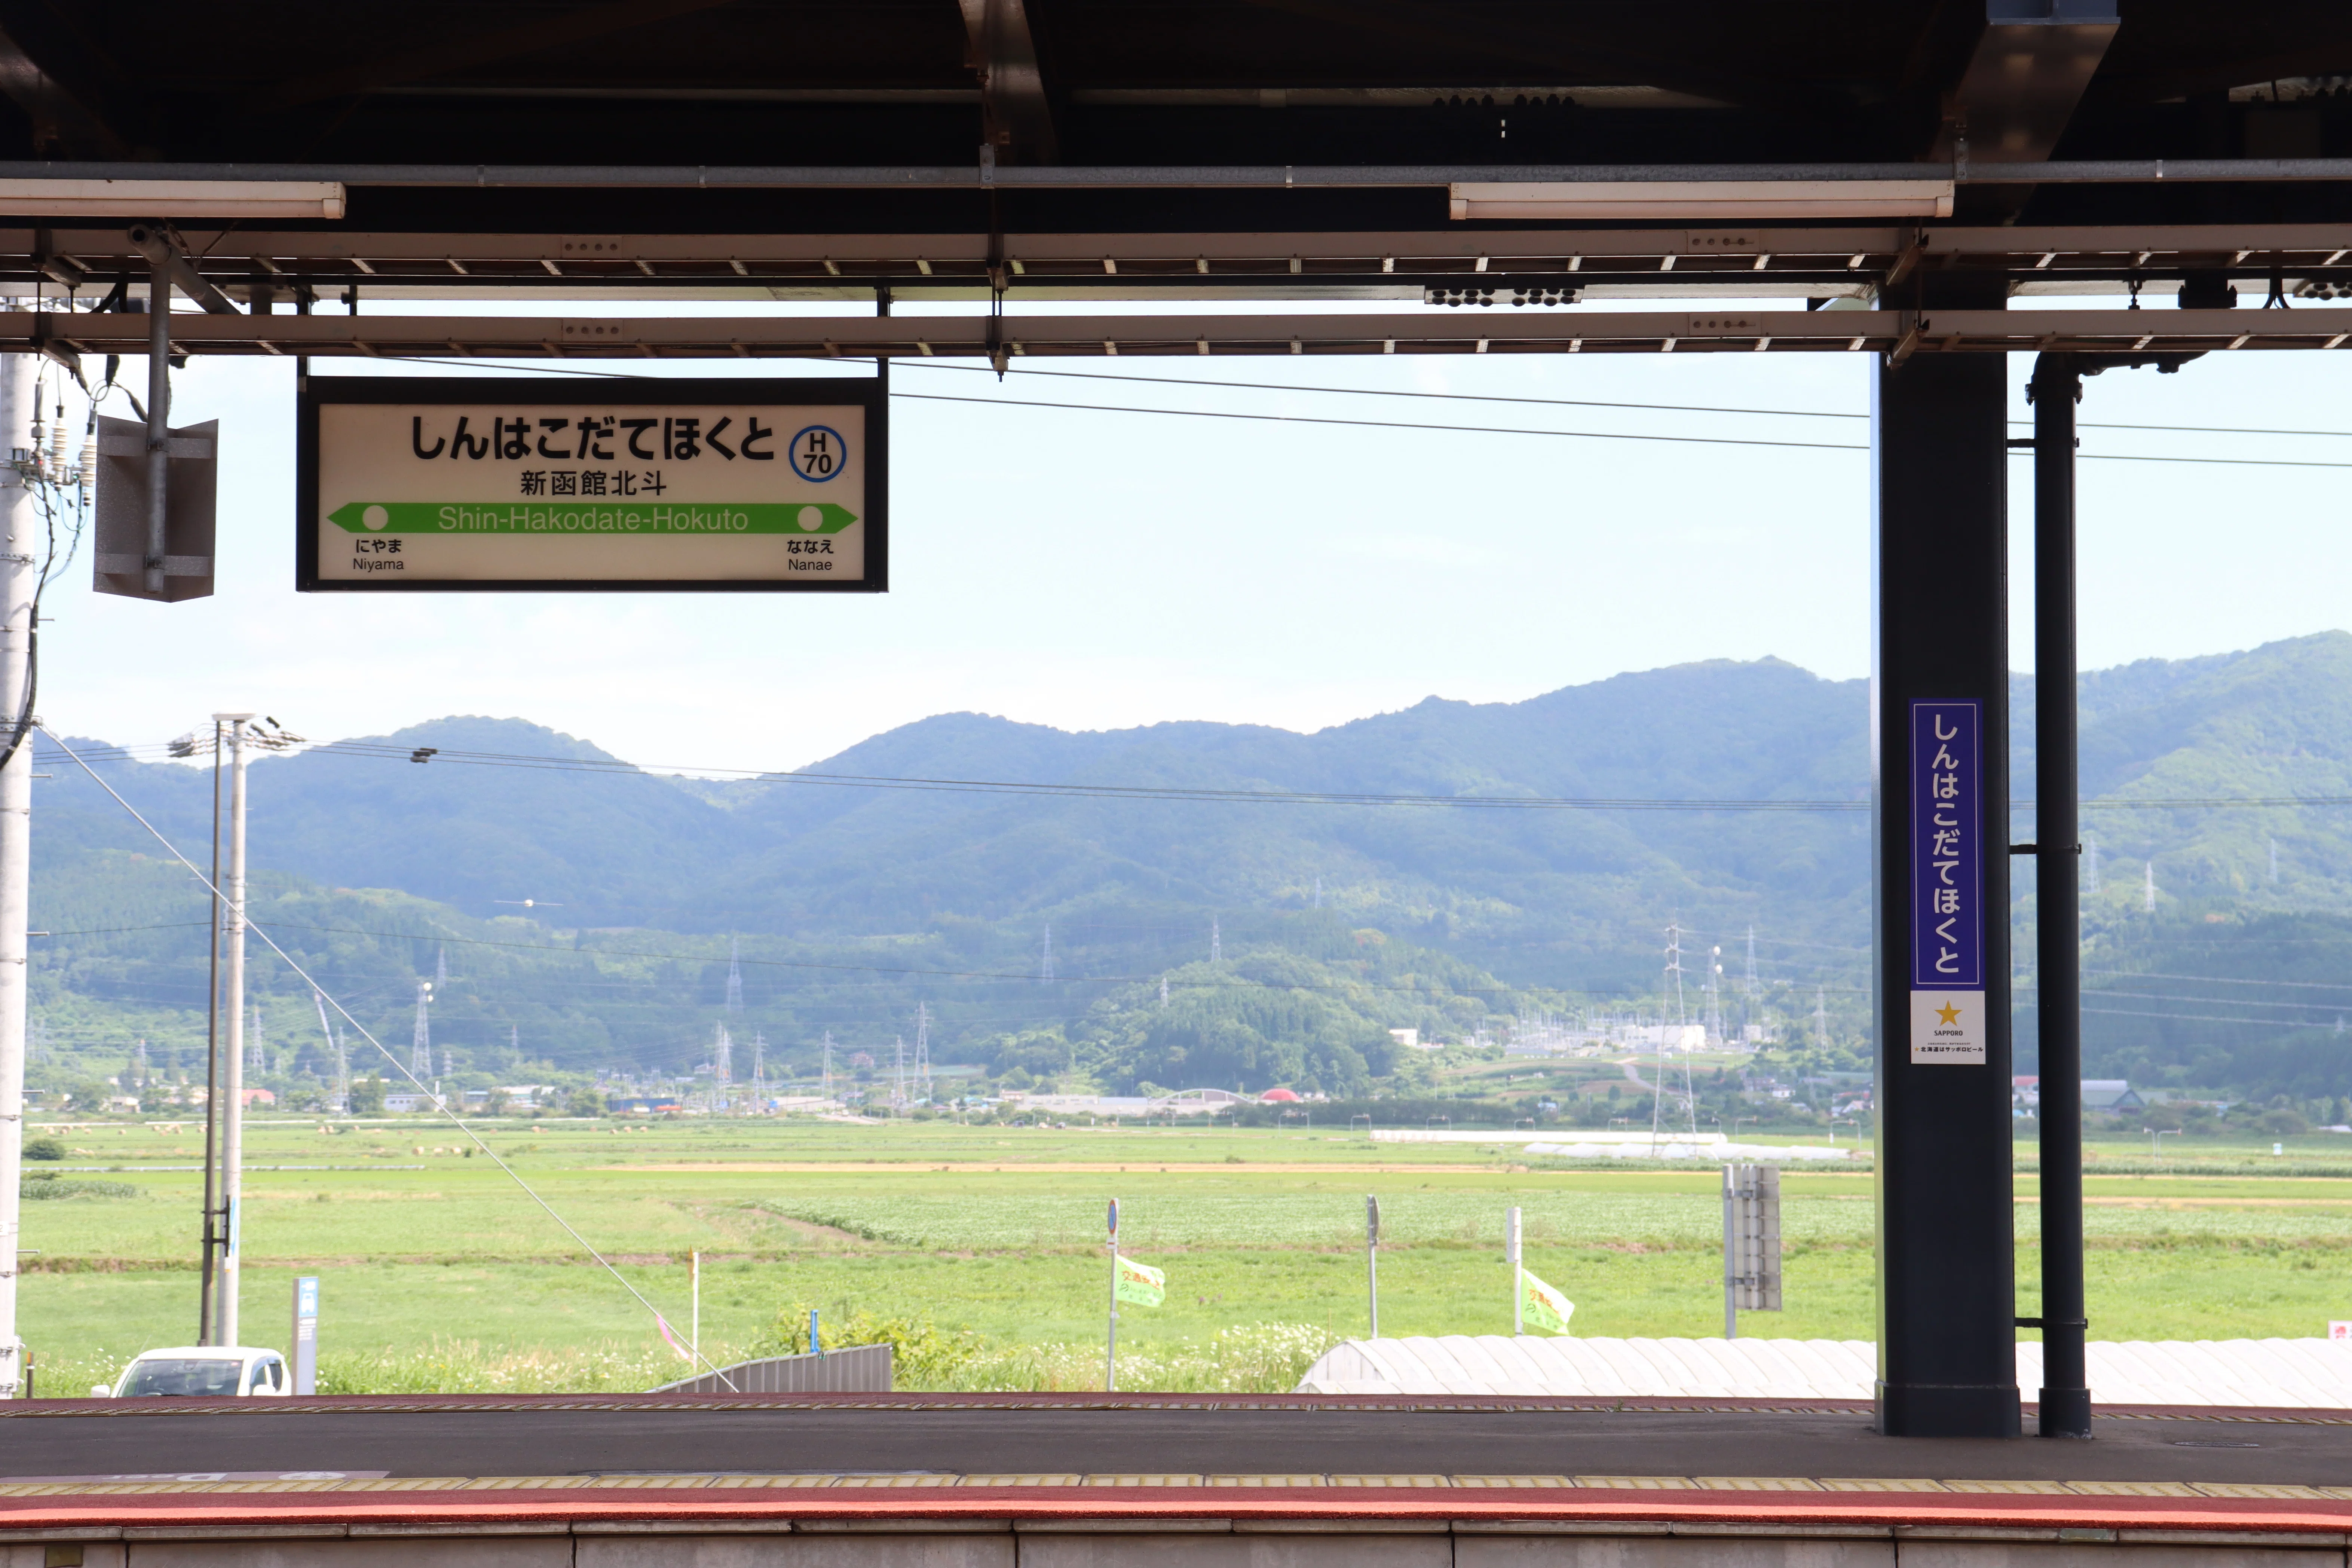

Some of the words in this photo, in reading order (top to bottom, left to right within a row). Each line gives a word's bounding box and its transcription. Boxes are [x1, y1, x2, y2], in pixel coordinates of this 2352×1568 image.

[413, 415, 775, 461] しんはこだてほくと
[810, 433, 826, 452] H
[803, 454, 832, 474] 70
[520, 470, 667, 496] 新函館北斗
[439, 506, 748, 530] Shin-Hakodate-Hokuto
[356, 539, 402, 554] にやま
[787, 539, 834, 554] ななえ
[353, 558, 404, 573] Niyama
[788, 558, 833, 571] Nanae
[1931, 714, 1961, 974] しんはこだてほくと
[101, 1473, 229, 1482] Deer
